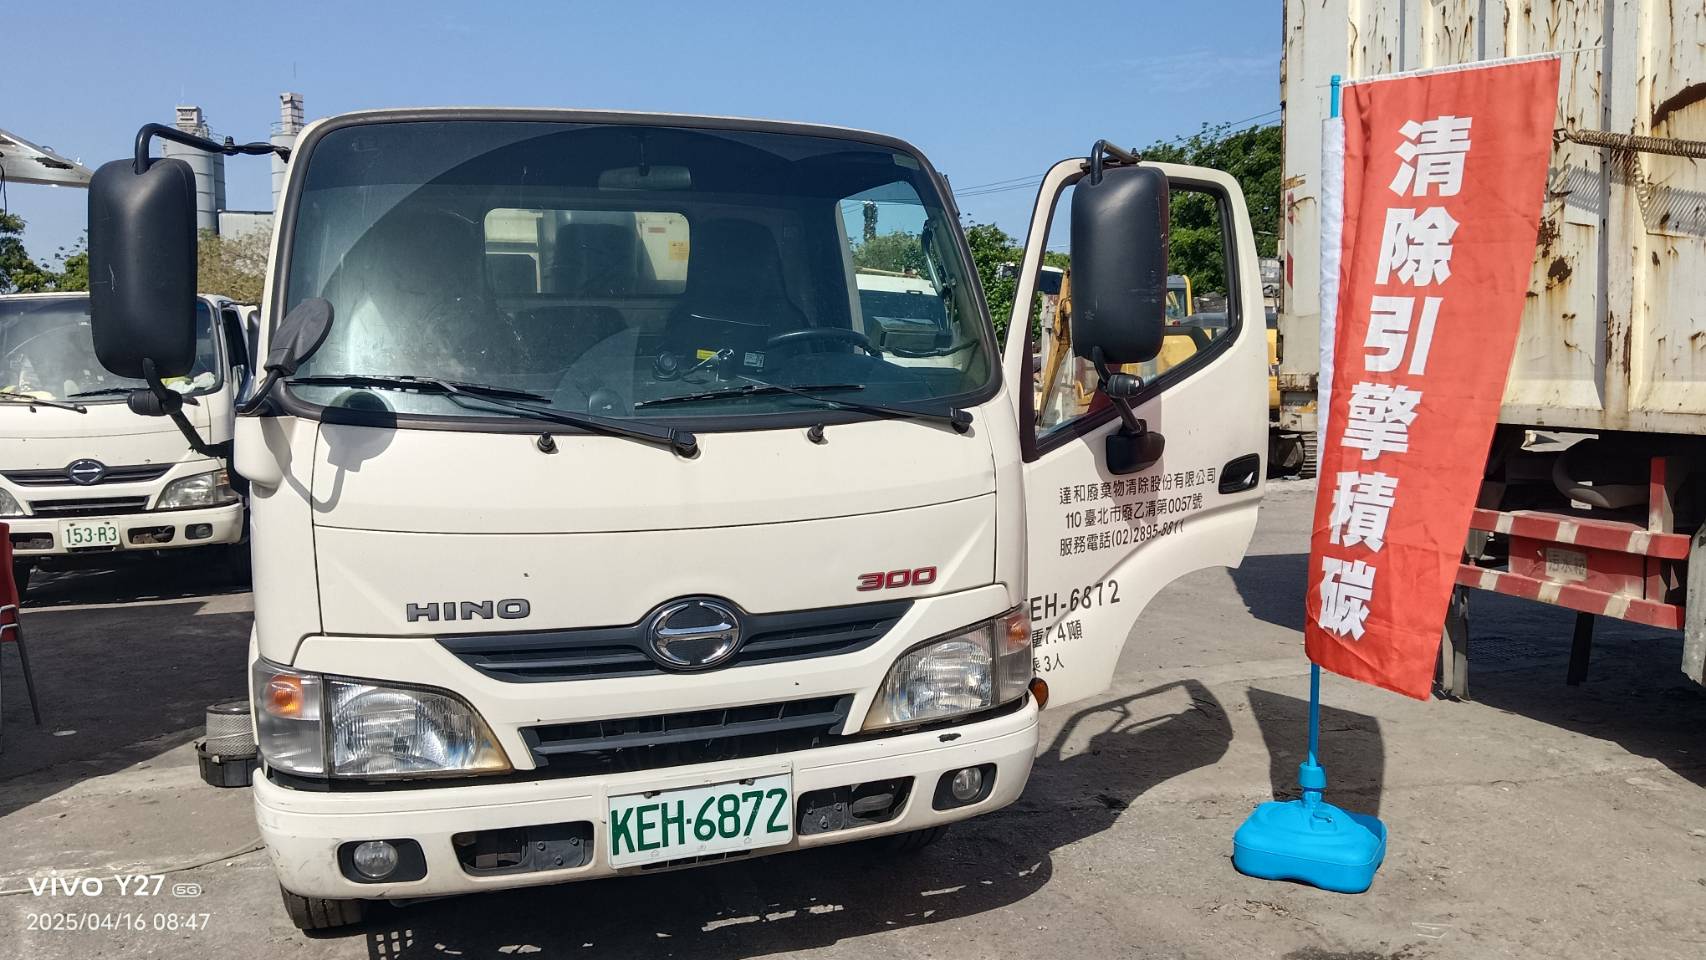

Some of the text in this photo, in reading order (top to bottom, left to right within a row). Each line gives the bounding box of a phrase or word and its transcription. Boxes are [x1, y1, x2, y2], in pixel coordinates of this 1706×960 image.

[1319, 115, 1472, 642] 清除引擎積碳
[1059, 467, 1216, 505] 達和廢棄物清除股份有限公司
[65, 524, 117, 543] 153-R3
[856, 565, 938, 592] 300
[405, 598, 531, 623] HINO
[610, 787, 789, 856] KEH-6872
